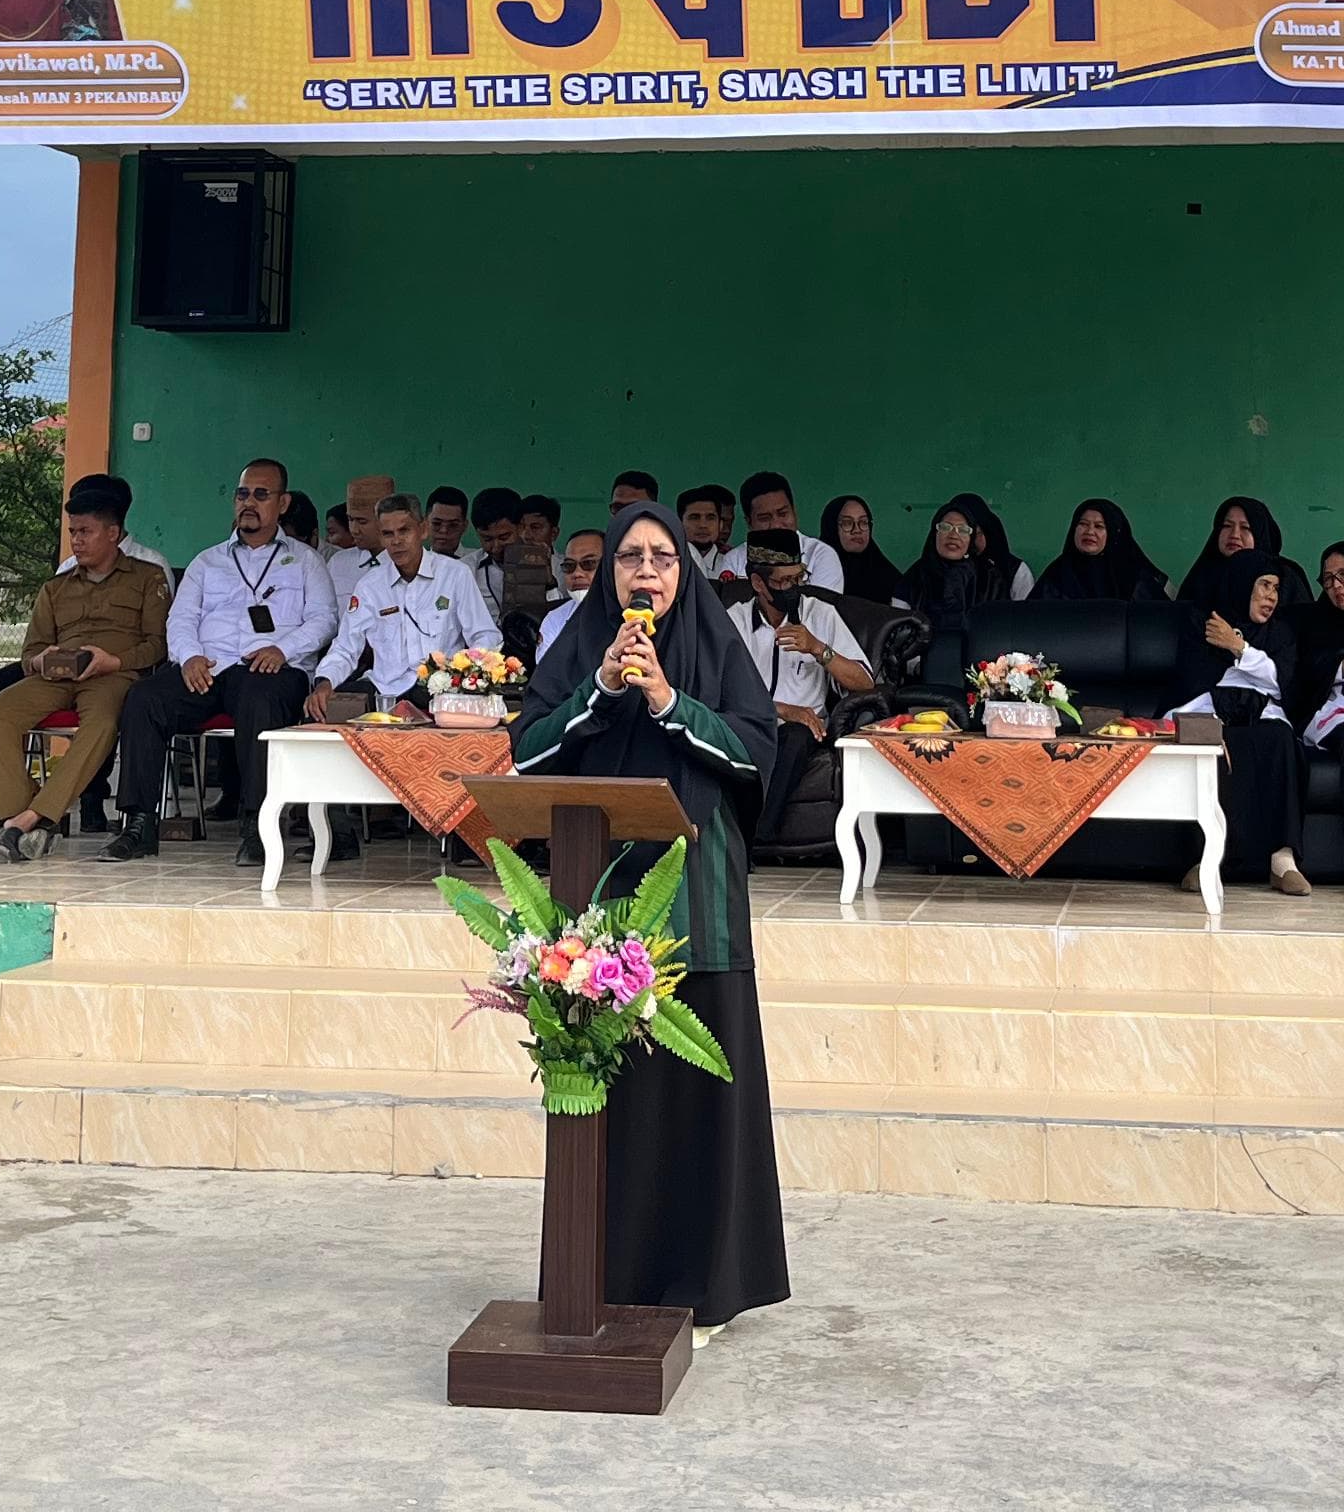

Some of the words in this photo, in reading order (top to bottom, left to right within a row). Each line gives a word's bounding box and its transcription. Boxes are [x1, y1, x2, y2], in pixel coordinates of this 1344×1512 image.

[1272, 20, 1341, 37] Ahmad
[104, 52, 164, 70] M.Pd.
[467, 76, 548, 104] THE
[563, 74, 706, 107] SPIRIT,
[721, 69, 865, 99] SMASH
[879, 66, 963, 96] THE
[33, 92, 70, 105] MAN
[74, 91, 82, 104] 3
[84, 90, 184, 104] PEKANBARU
